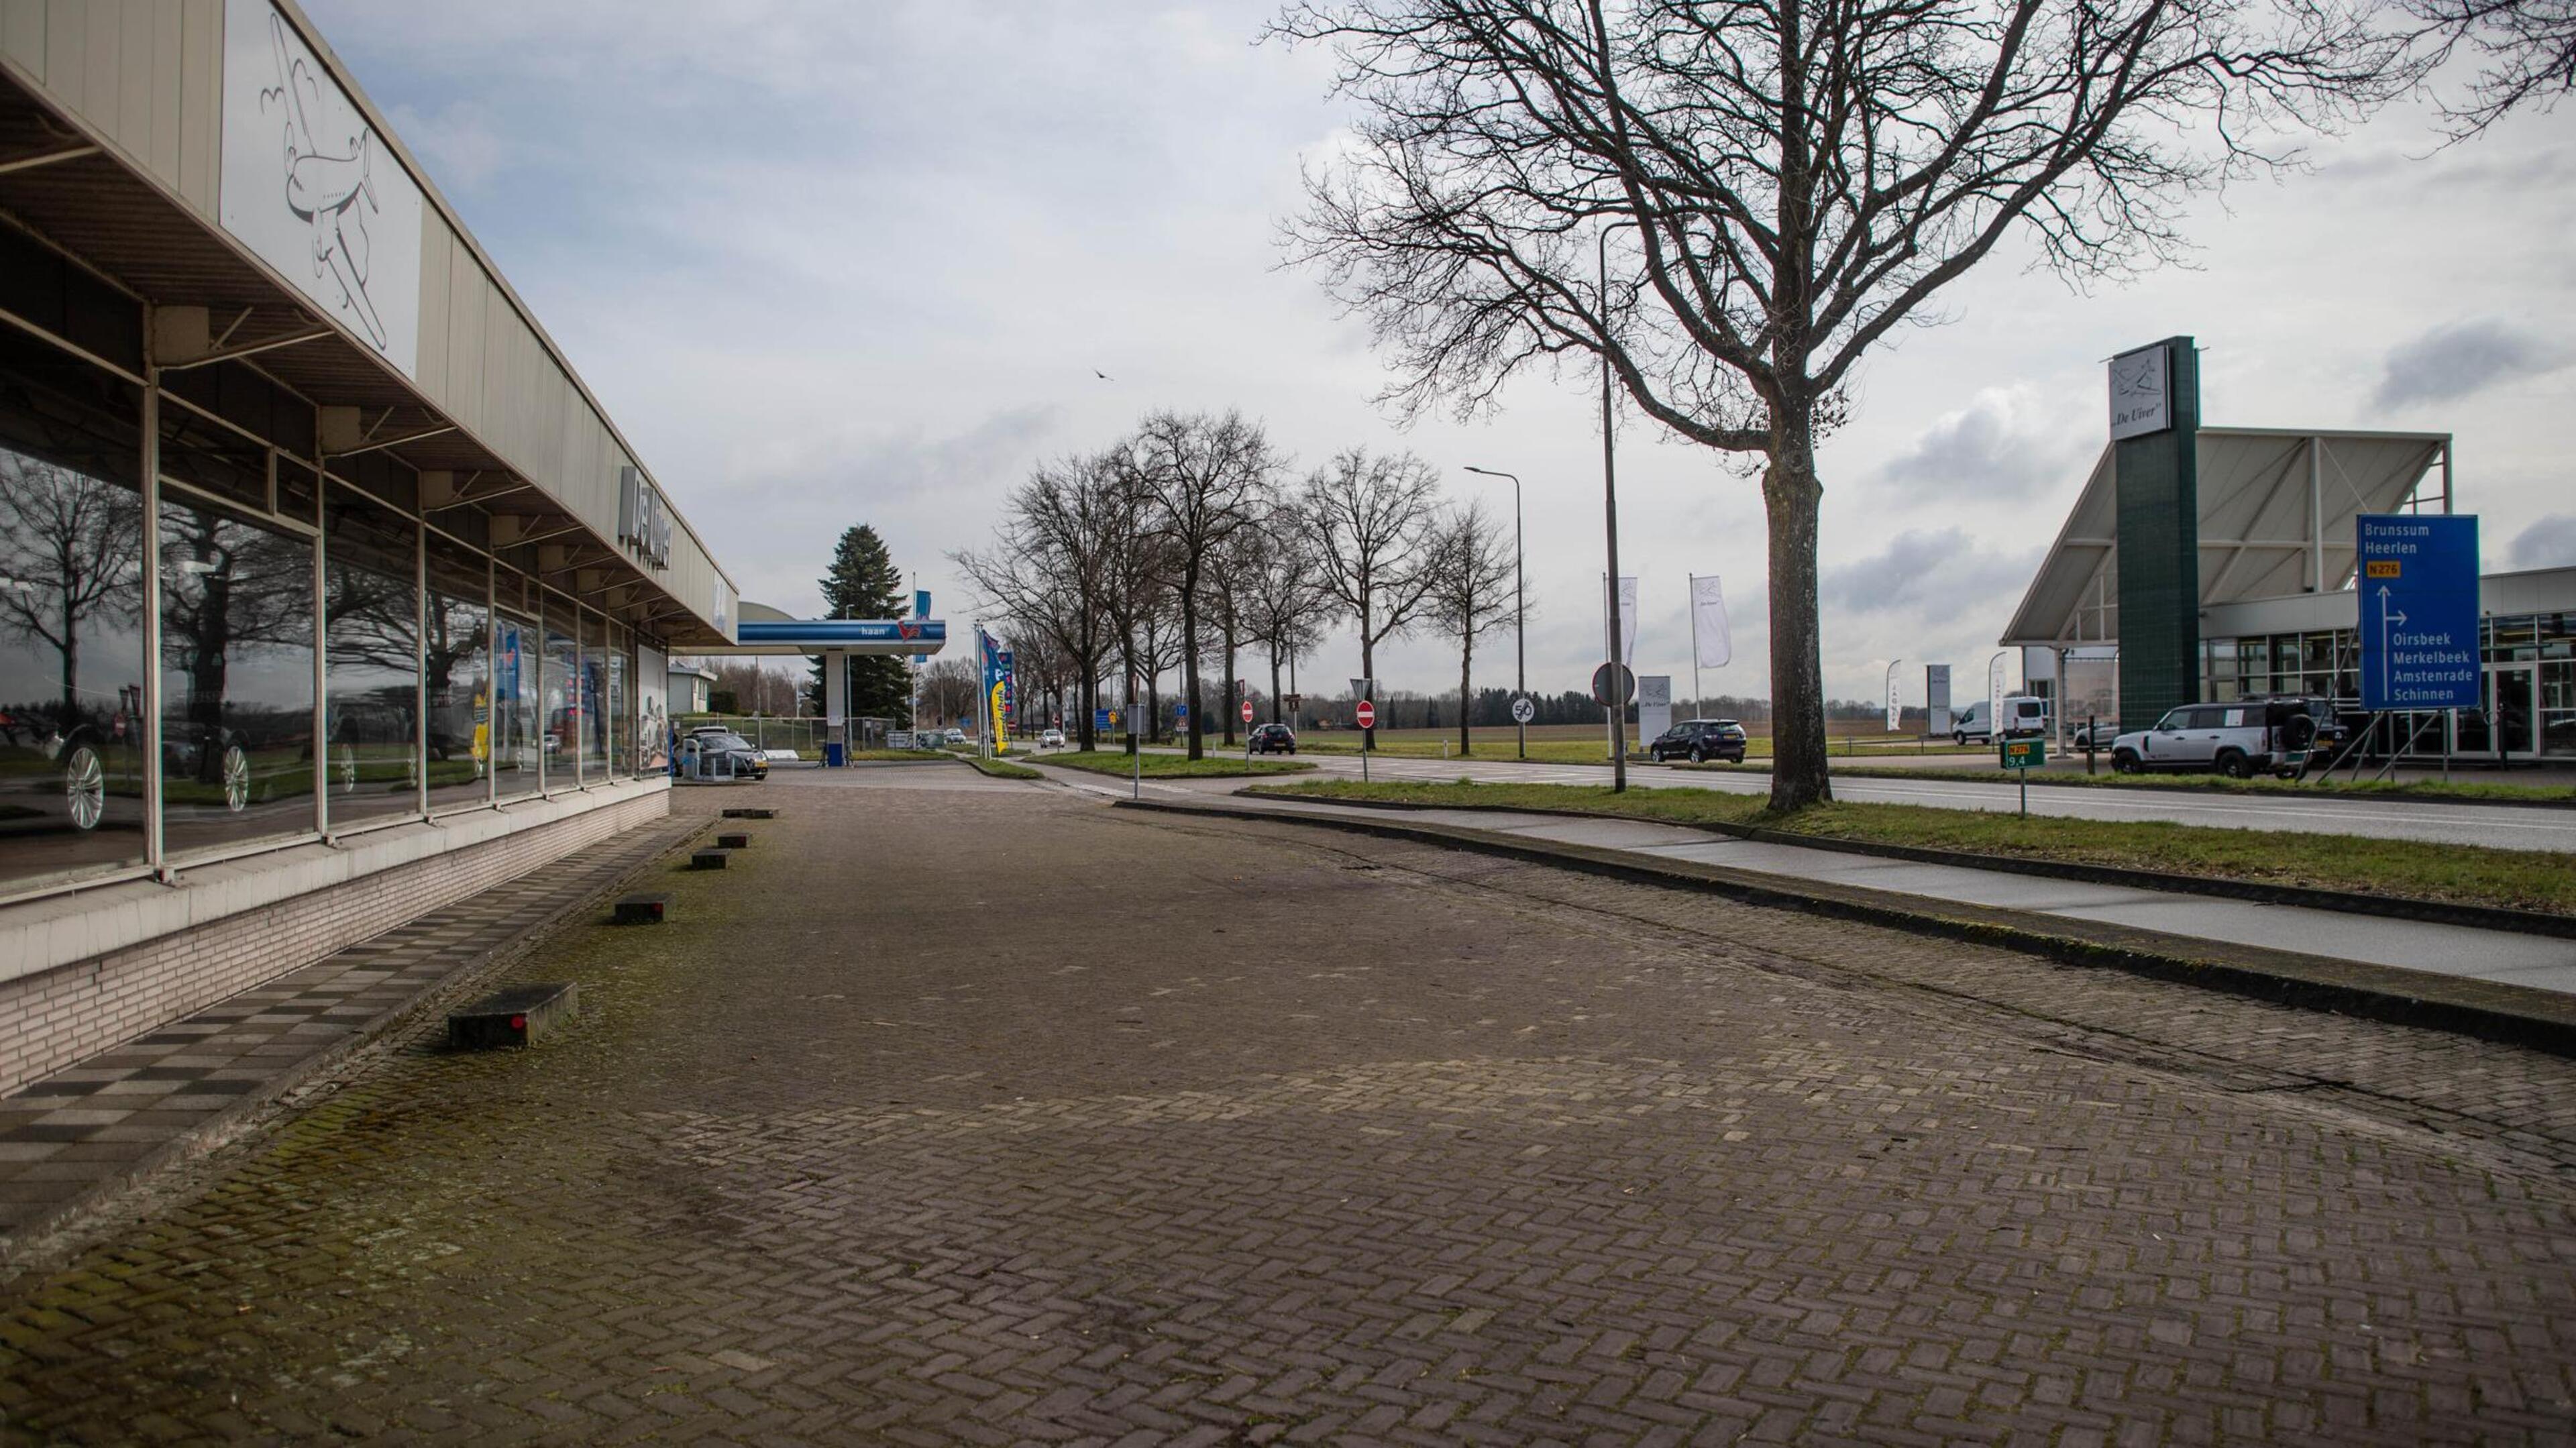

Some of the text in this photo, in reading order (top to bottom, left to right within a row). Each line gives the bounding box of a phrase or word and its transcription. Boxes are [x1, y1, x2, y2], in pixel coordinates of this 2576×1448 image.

[2365, 523, 2429, 536] Brunssum
[2365, 541, 2417, 554] Heerlen
[2369, 564, 2398, 575] N276
[861, 626, 885, 635] haan
[2394, 632, 2451, 646] Oirsbeek
[2394, 651, 2470, 664] Merkelbeek
[2394, 669, 2473, 682] Amstenrade
[2394, 688, 2454, 701] Schinnen
[1515, 705, 1532, 716] 50
[2009, 756, 2025, 766] 9.4
